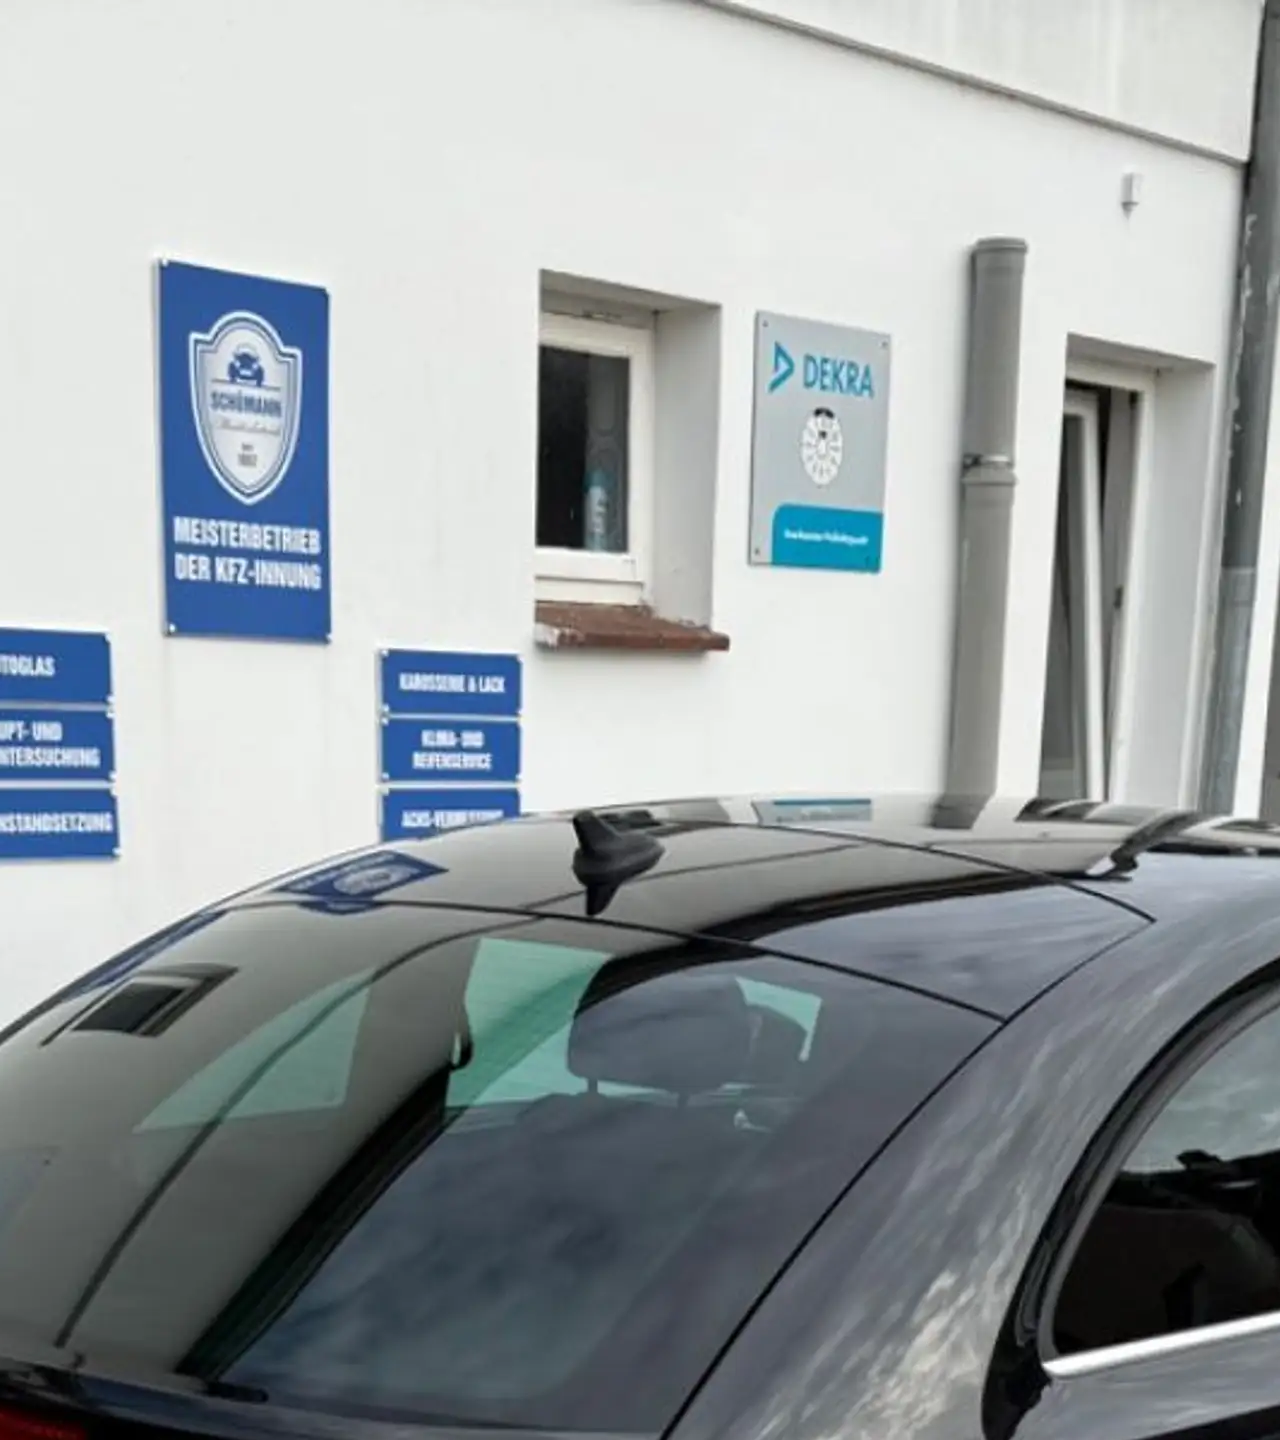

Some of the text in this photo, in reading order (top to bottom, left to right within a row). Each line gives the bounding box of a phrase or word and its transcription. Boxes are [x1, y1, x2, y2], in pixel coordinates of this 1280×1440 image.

[803, 354, 874, 399] DEKRA
[174, 516, 321, 554] MEISTERBETRIEB
[175, 553, 322, 590] DER KFZ-INNUNG
[479, 676, 506, 693] LACK
[32, 721, 63, 741] UND
